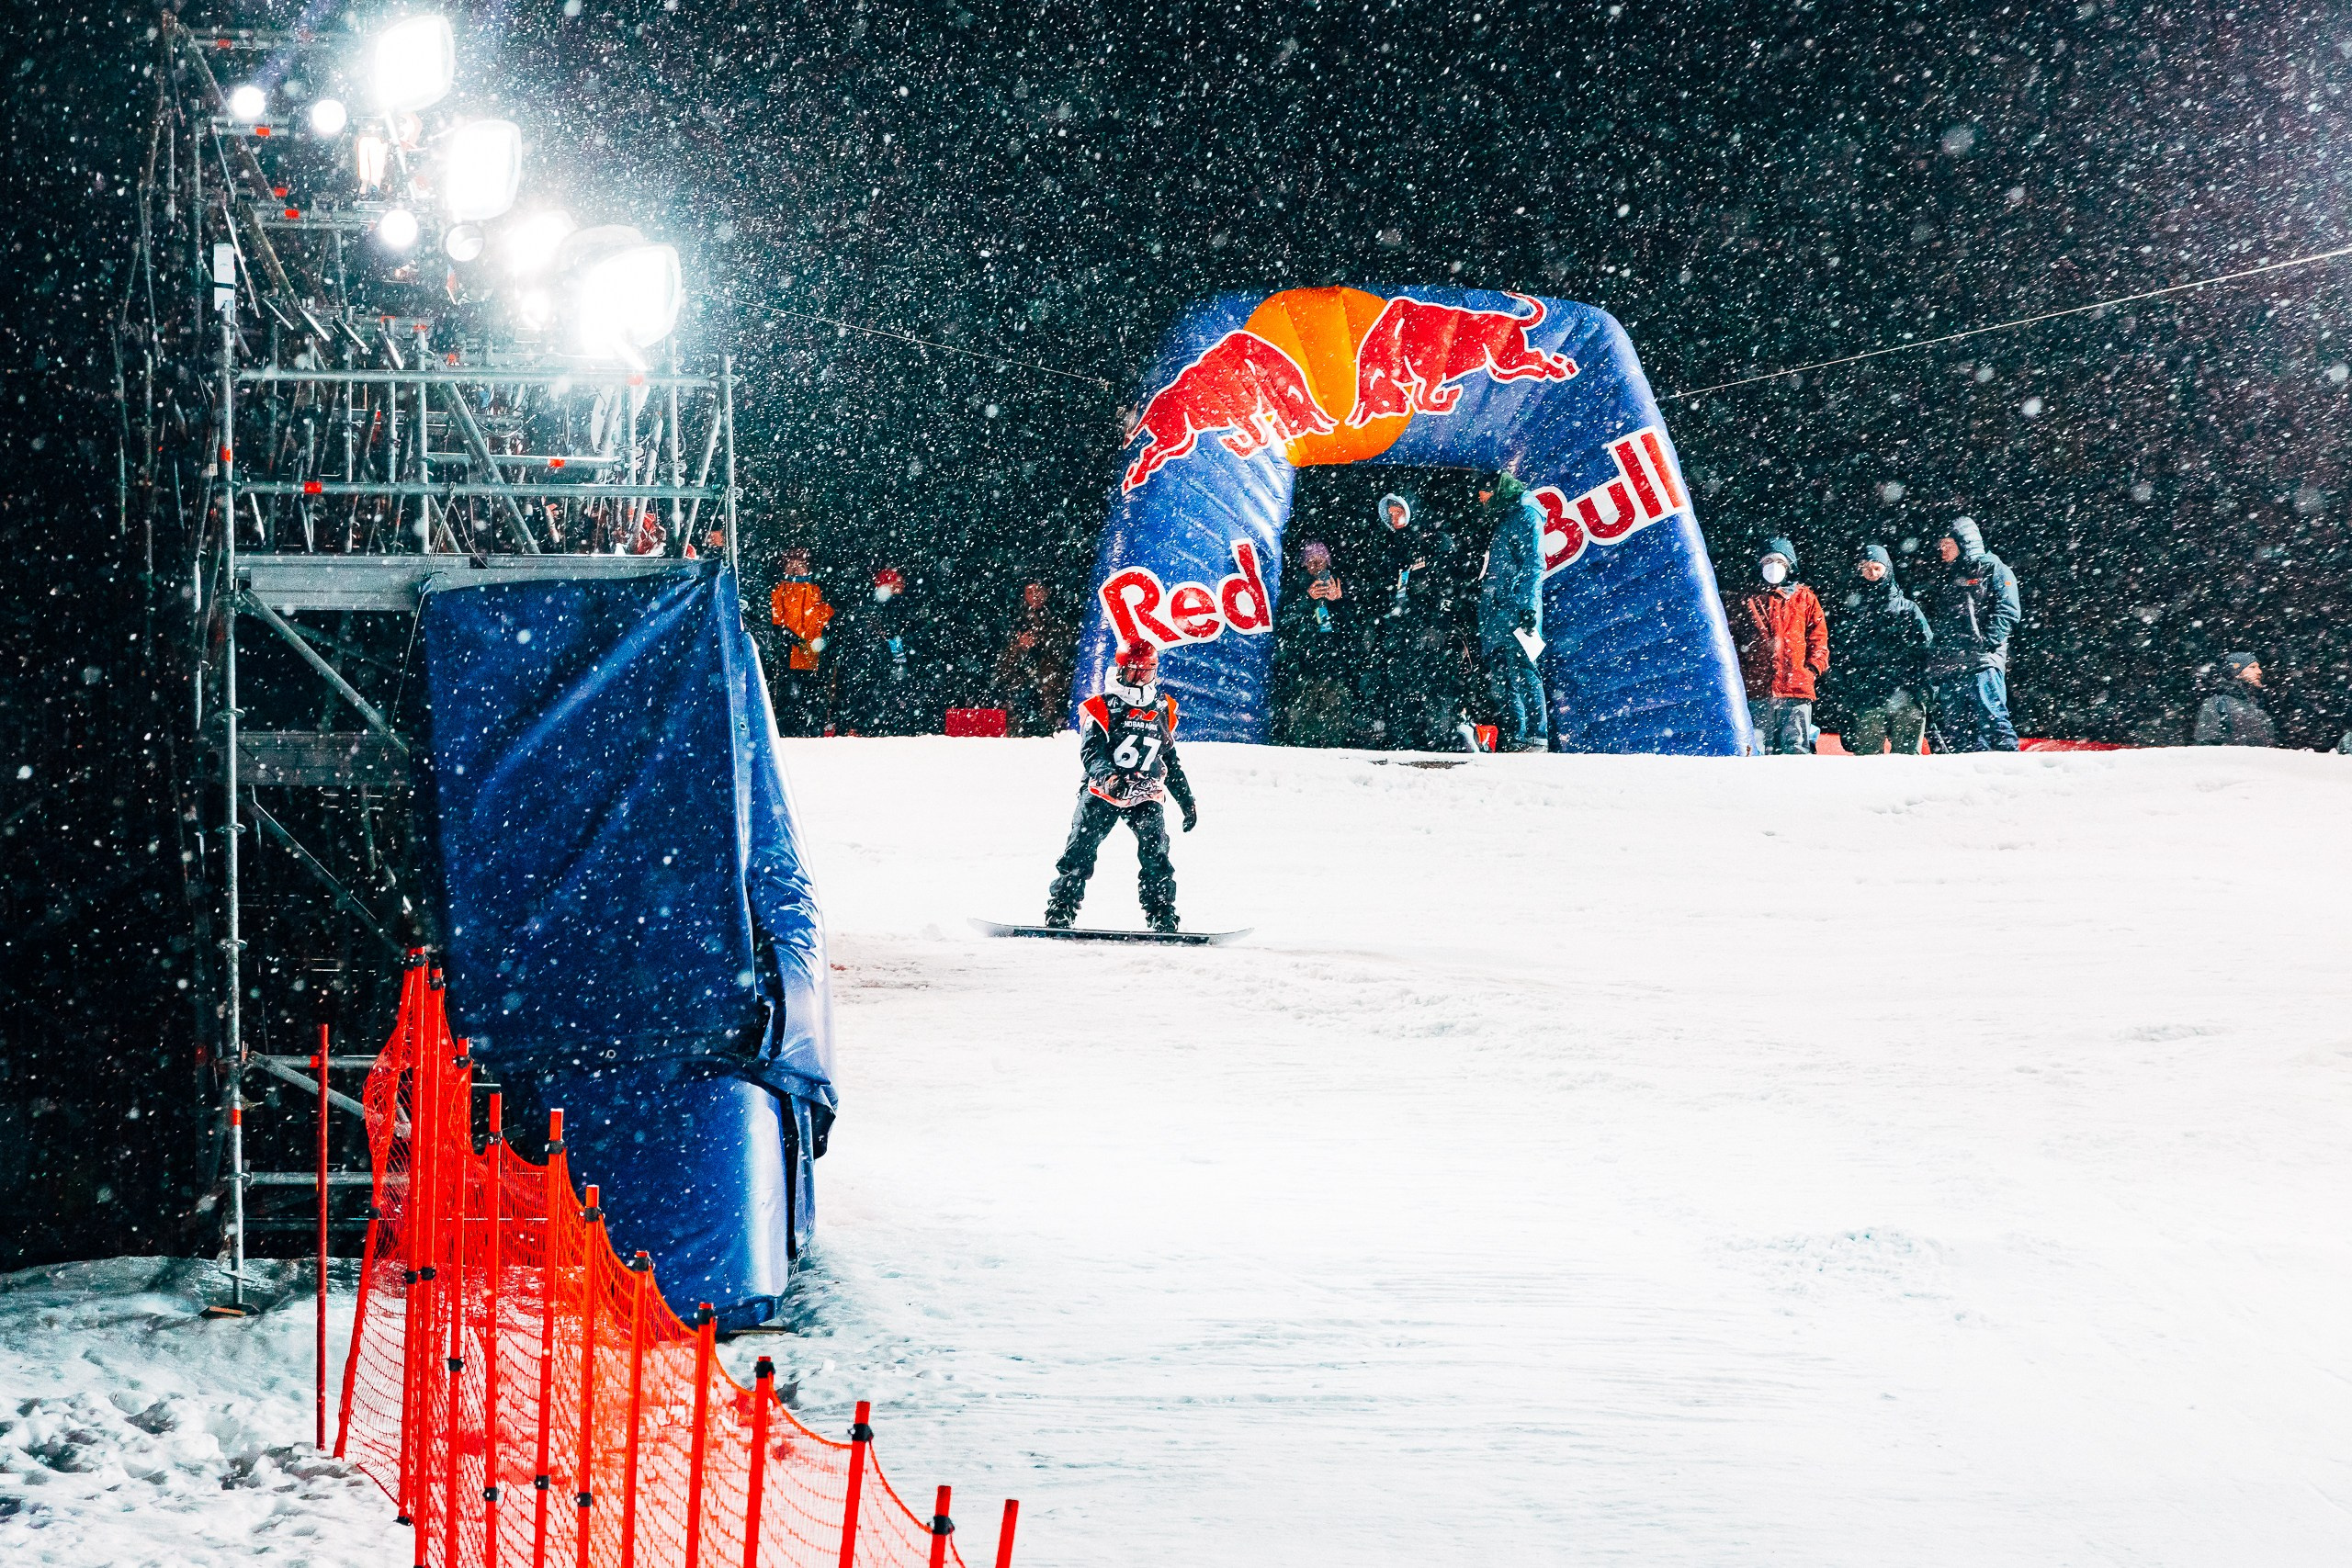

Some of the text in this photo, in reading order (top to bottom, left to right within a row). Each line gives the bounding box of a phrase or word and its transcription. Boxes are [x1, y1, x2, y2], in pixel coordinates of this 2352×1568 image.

[1100, 427, 1688, 645] Red Bull
[1114, 734, 1162, 772] 67
